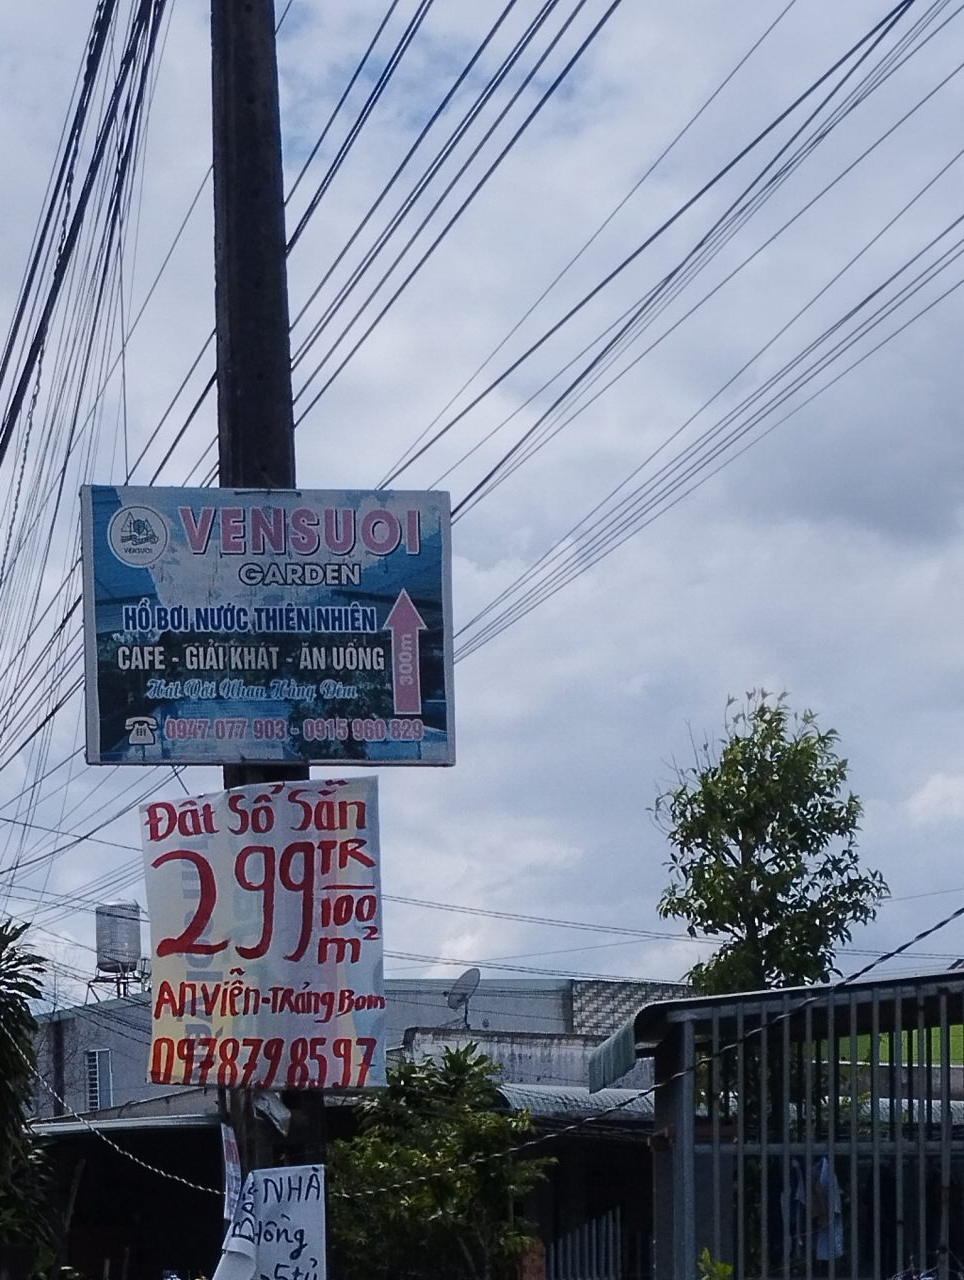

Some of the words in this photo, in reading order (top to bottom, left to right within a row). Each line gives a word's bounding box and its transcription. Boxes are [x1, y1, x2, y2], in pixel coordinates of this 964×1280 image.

[178, 506, 421, 557] VENSUOI
[239, 563, 361, 586] GARDEN
[123, 597, 151, 632] HỒ
[156, 604, 189, 632] BƠI
[195, 602, 249, 631] NƯỚC
[254, 603, 310, 632] THIÊN
[316, 601, 376, 632] NHIÊN
[117, 646, 166, 670] CAFE
[185, 639, 224, 670] GIẢI
[230, 641, 279, 670] KHÁT
[299, 642, 326, 670] ĂN
[332, 639, 384, 670] UỐNG
[398, 633, 414, 686] 300m
[165, 718, 208, 740] 0947
[215, 718, 248, 740] 077
[254, 718, 287, 741] 903
[303, 718, 348, 741] 0915
[151, 842, 315, 962] 299
[317, 838, 376, 875] TR
[322, 894, 377, 927] 100
[263, 1166, 320, 1203] NHÀ
